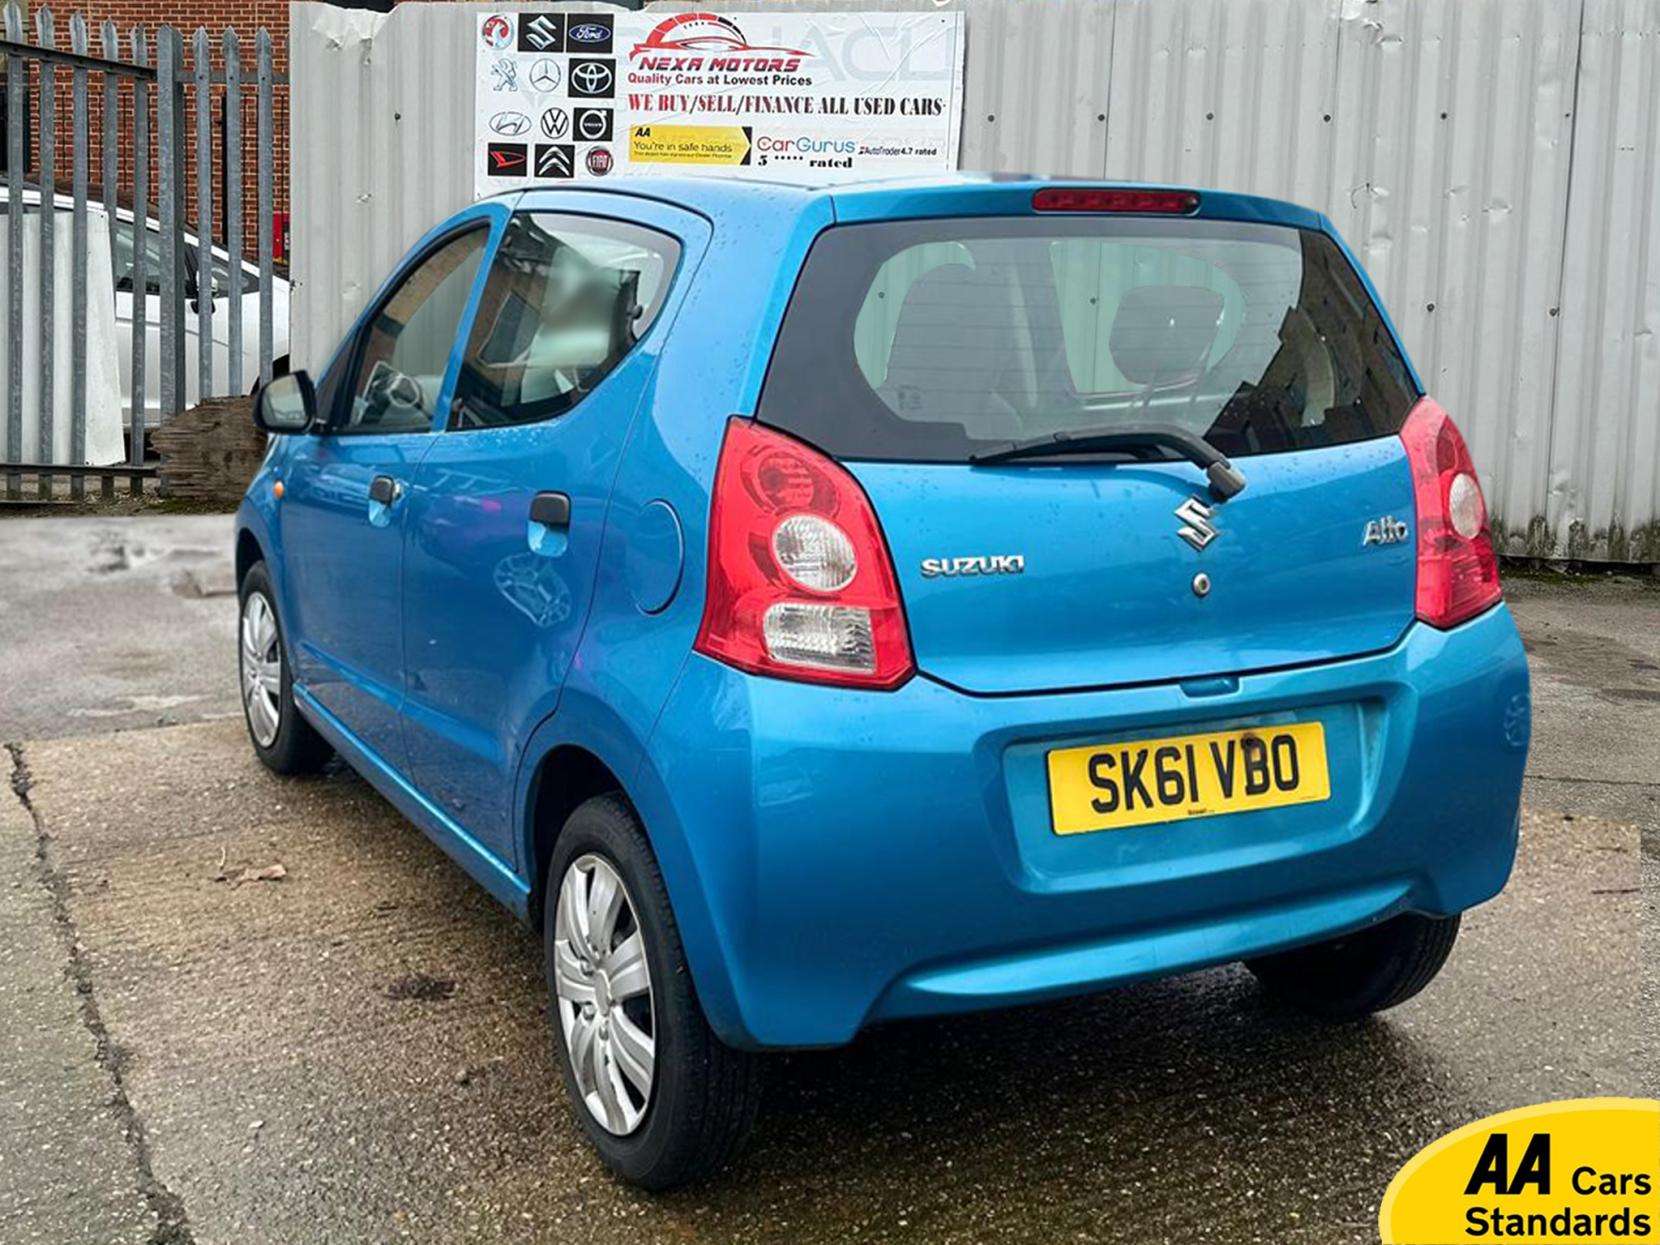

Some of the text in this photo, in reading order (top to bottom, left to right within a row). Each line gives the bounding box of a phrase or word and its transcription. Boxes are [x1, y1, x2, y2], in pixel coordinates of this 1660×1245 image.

[577, 24, 603, 39] Ford
[639, 57, 800, 72] NEXA MOTORS
[628, 73, 812, 86] Quality Cars at Lowest Prices
[628, 94, 942, 116] WE BUY/SELL/FINANCE ALL USED CARS
[635, 127, 651, 137] AA
[634, 141, 733, 153] You're in safe hands
[757, 136, 855, 153] CarGurus
[901, 147, 913, 155] 4.7
[915, 148, 937, 156] rated
[758, 155, 853, 168] 5 rated
[1363, 515, 1408, 546] Alto
[921, 555, 1024, 578] SUZUKI
[1088, 734, 1299, 814] SK61 VBO
